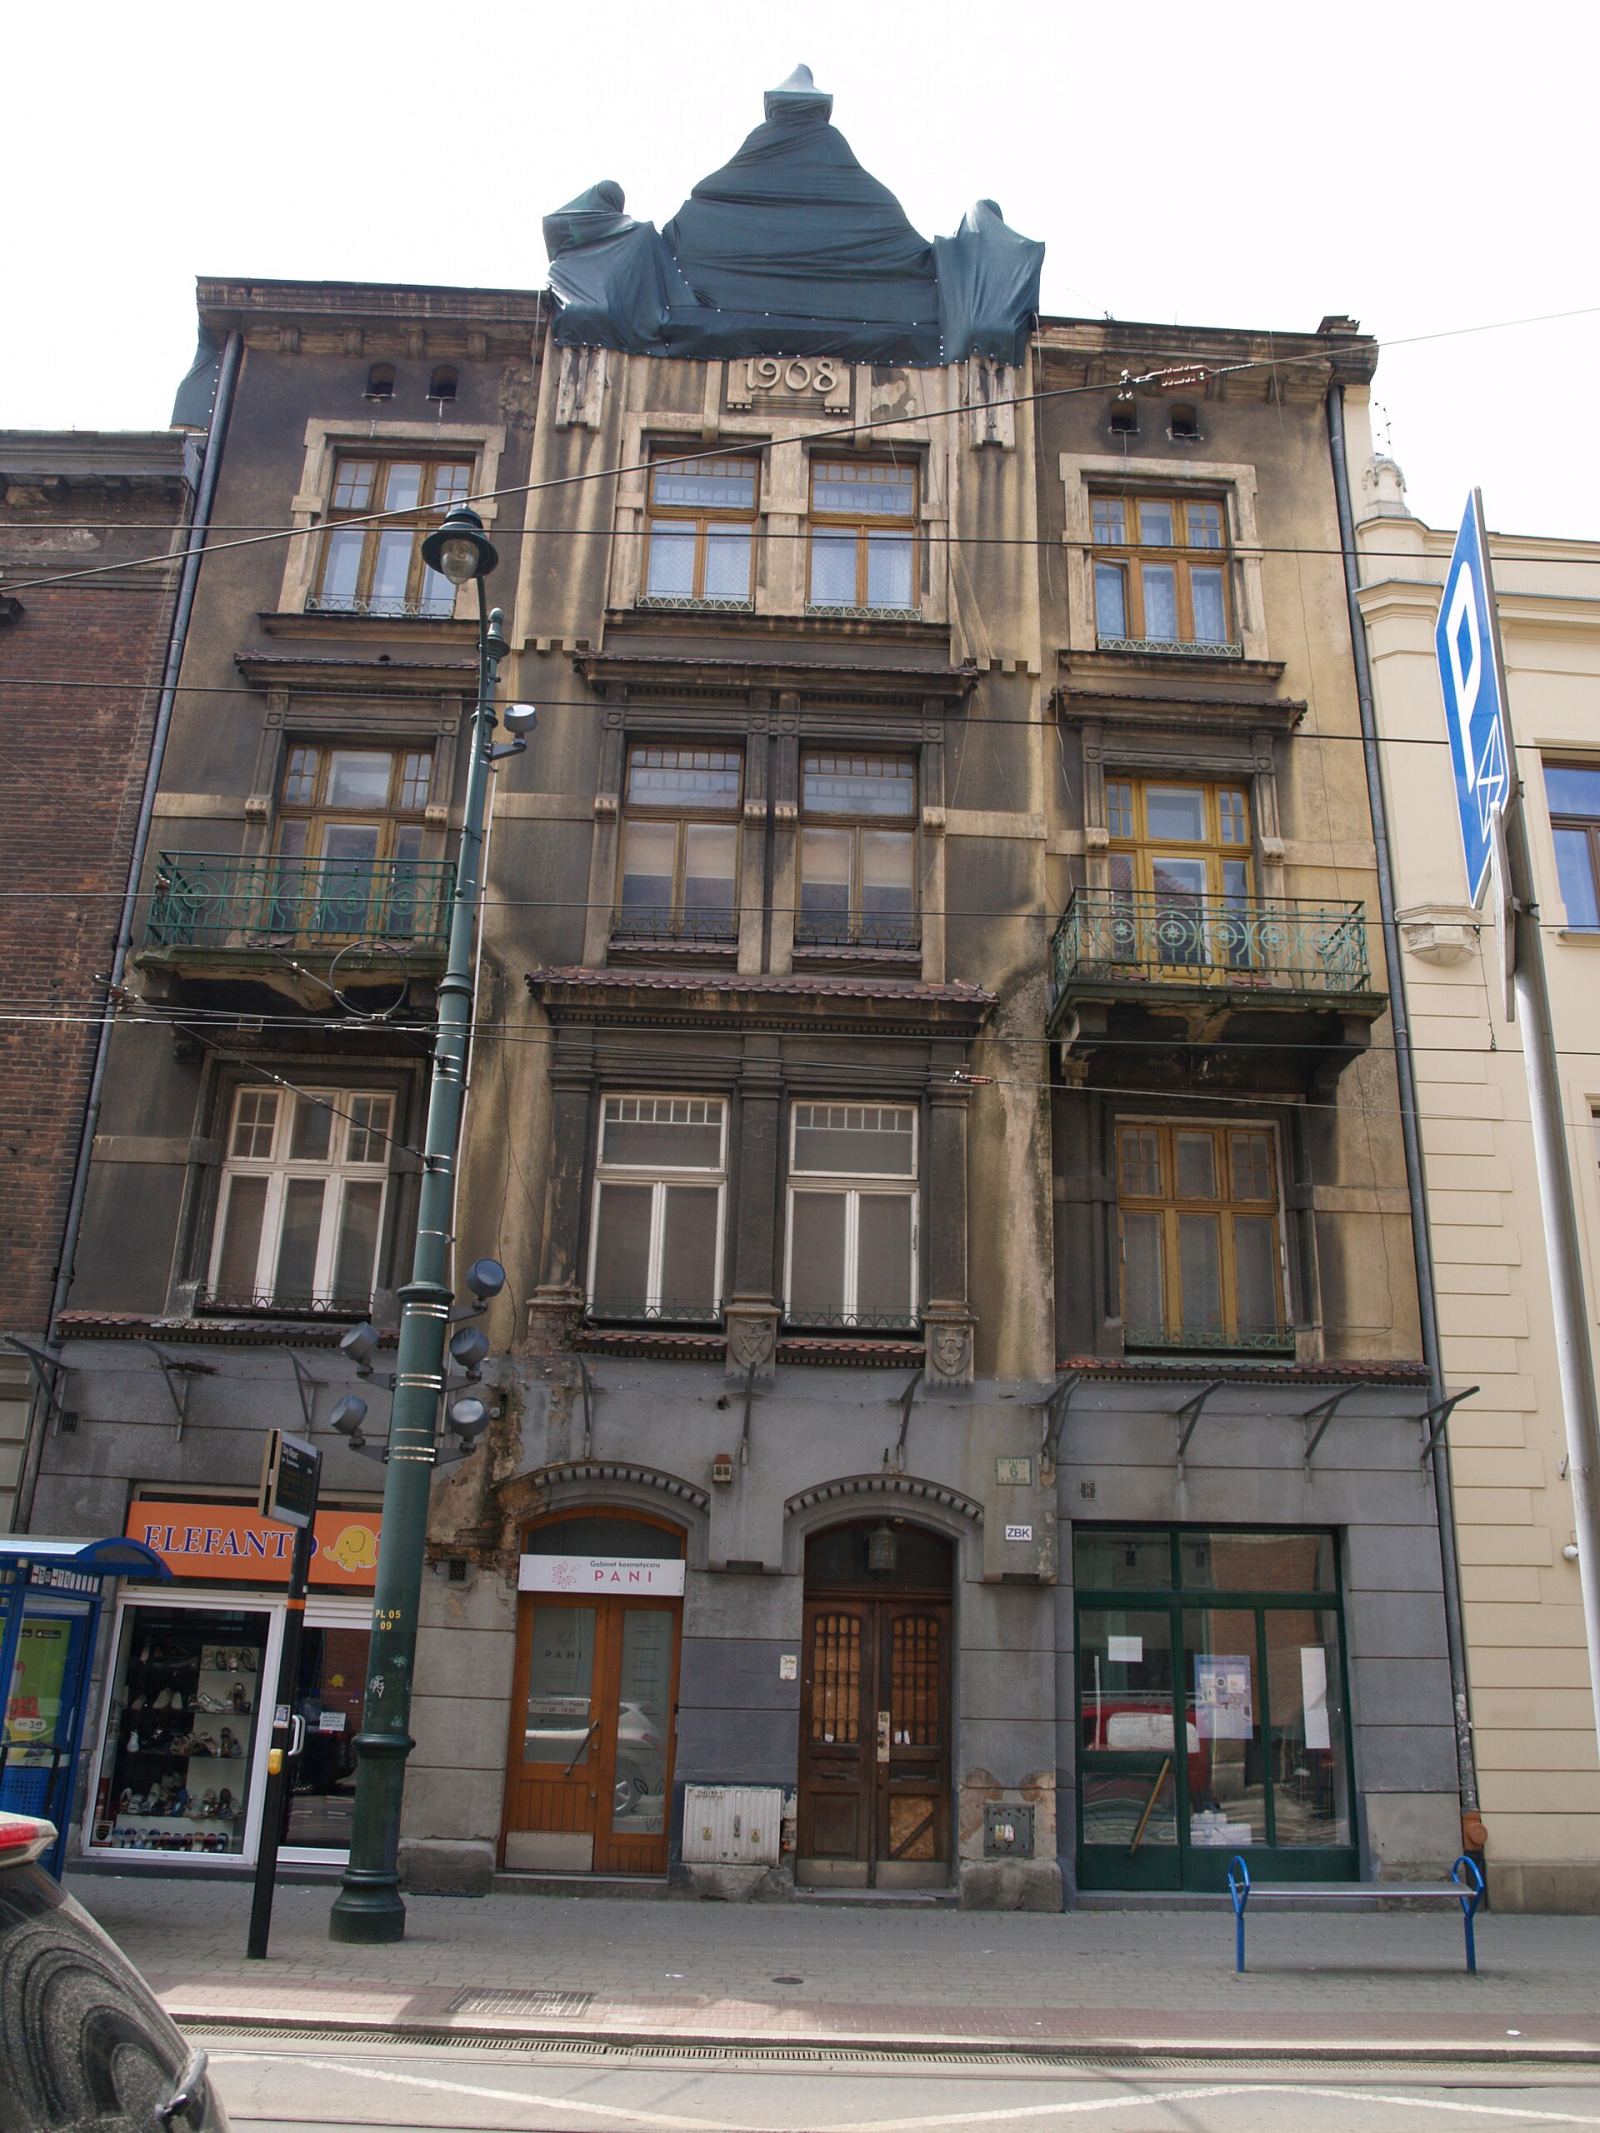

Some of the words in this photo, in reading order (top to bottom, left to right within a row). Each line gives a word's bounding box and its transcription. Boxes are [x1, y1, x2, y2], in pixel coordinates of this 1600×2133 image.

[743, 358, 838, 392] 1908
[1446, 560, 1482, 794] P
[1007, 1527, 1030, 1538] ZBK
[589, 1560, 617, 1568] Gabinet
[618, 1561, 661, 1569] kosmetyczny
[594, 1570, 652, 1583] PANI
[375, 1609, 386, 1618] PL
[388, 1610, 401, 1619] 05
[380, 1620, 392, 1630] 09
